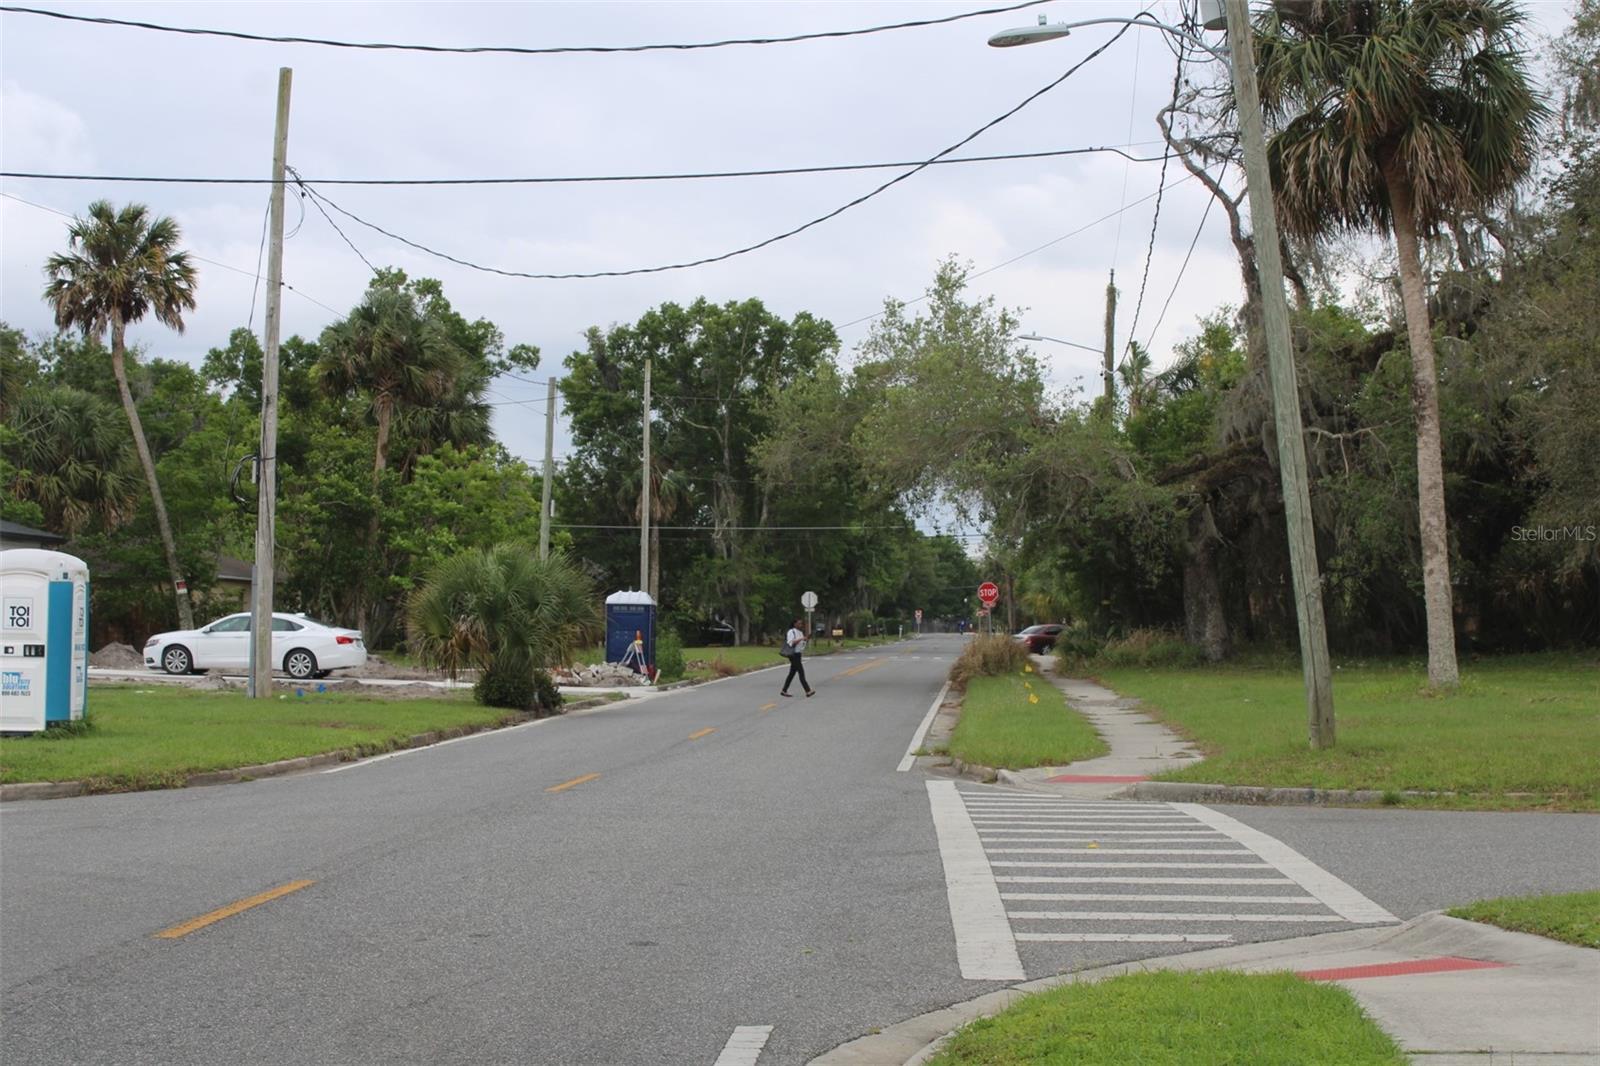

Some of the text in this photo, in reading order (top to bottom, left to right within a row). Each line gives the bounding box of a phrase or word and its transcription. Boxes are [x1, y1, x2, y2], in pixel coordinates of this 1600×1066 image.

[980, 588, 996, 596] STOP
[10, 606, 30, 616] TOI
[9, 616, 29, 627] TOI
